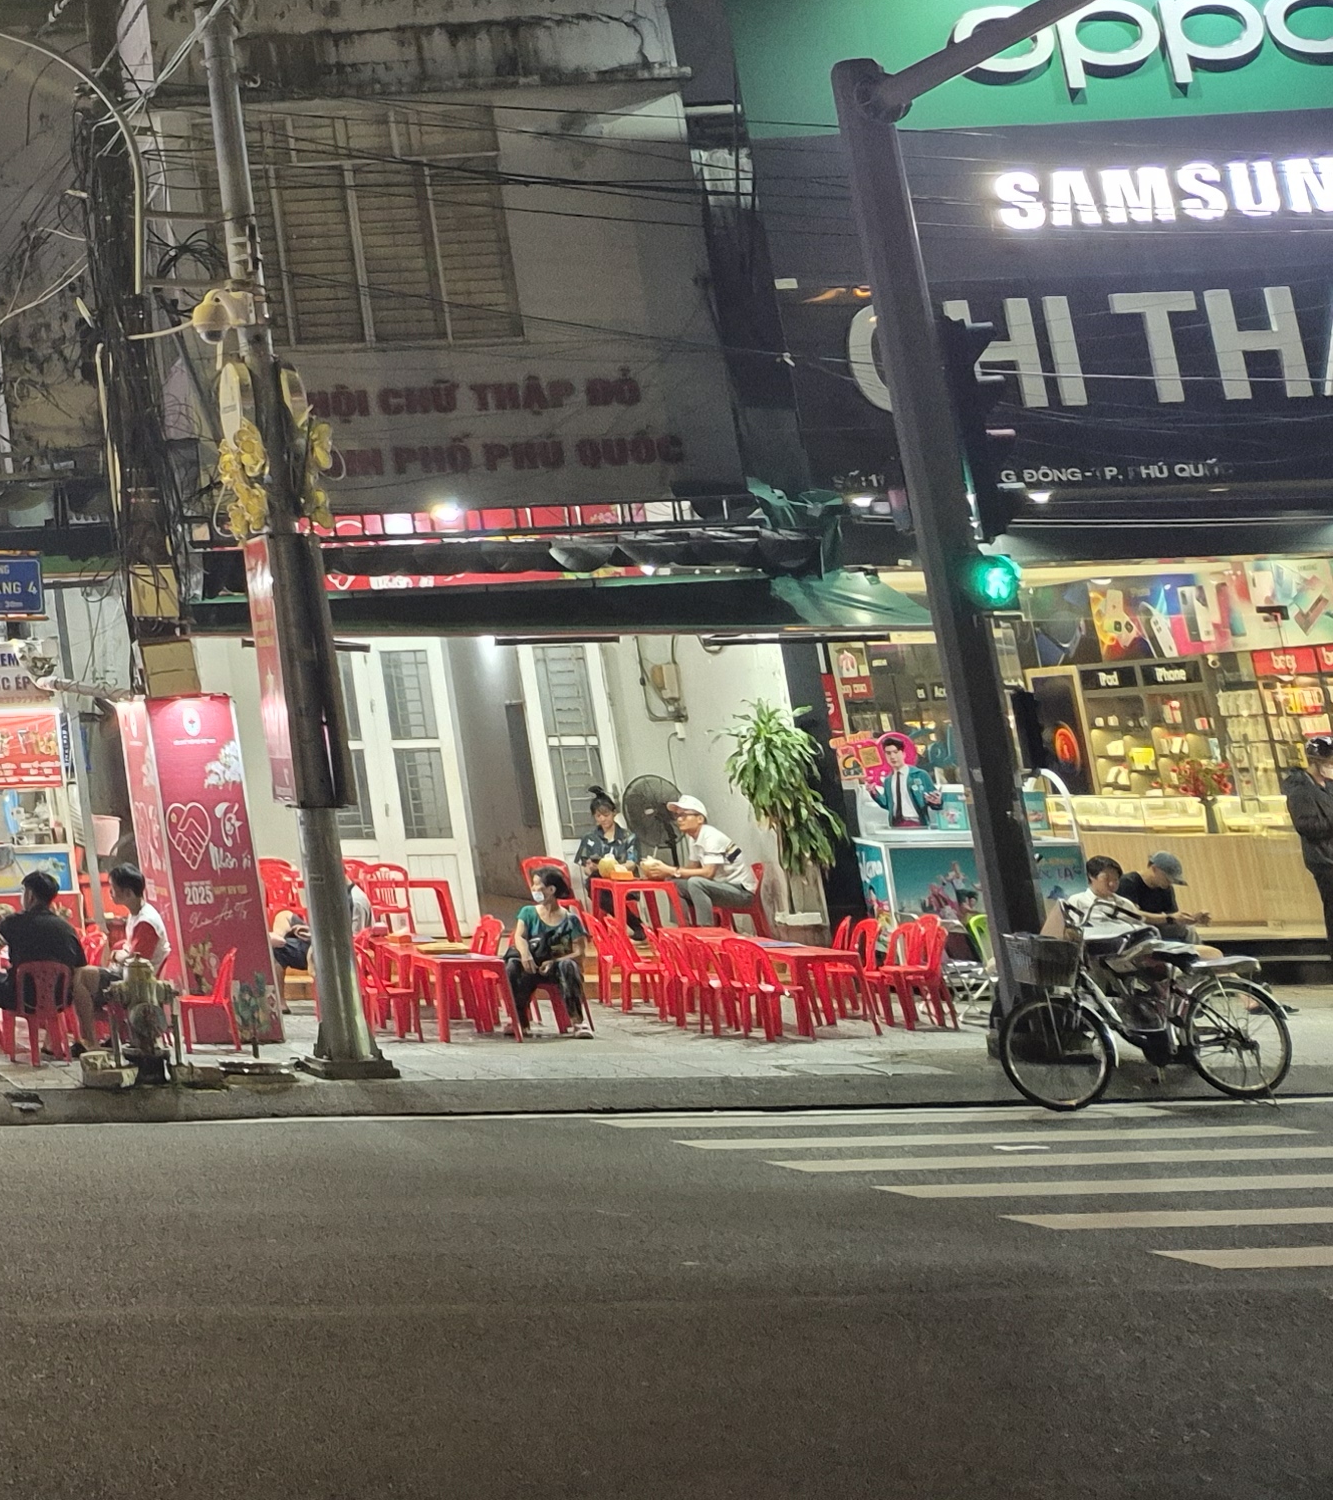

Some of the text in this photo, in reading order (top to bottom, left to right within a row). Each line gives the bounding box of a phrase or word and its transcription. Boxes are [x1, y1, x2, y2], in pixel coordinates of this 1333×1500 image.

[1108, 286, 1333, 404] TH
[470, 375, 575, 416] THẬP
[585, 366, 640, 407] ĐỎ
[27, 581, 38, 595] 4
[15, 674, 31, 691] ÉP
[1098, 666, 1187, 686] iPad iPhone
[184, 886, 215, 906] 2025
